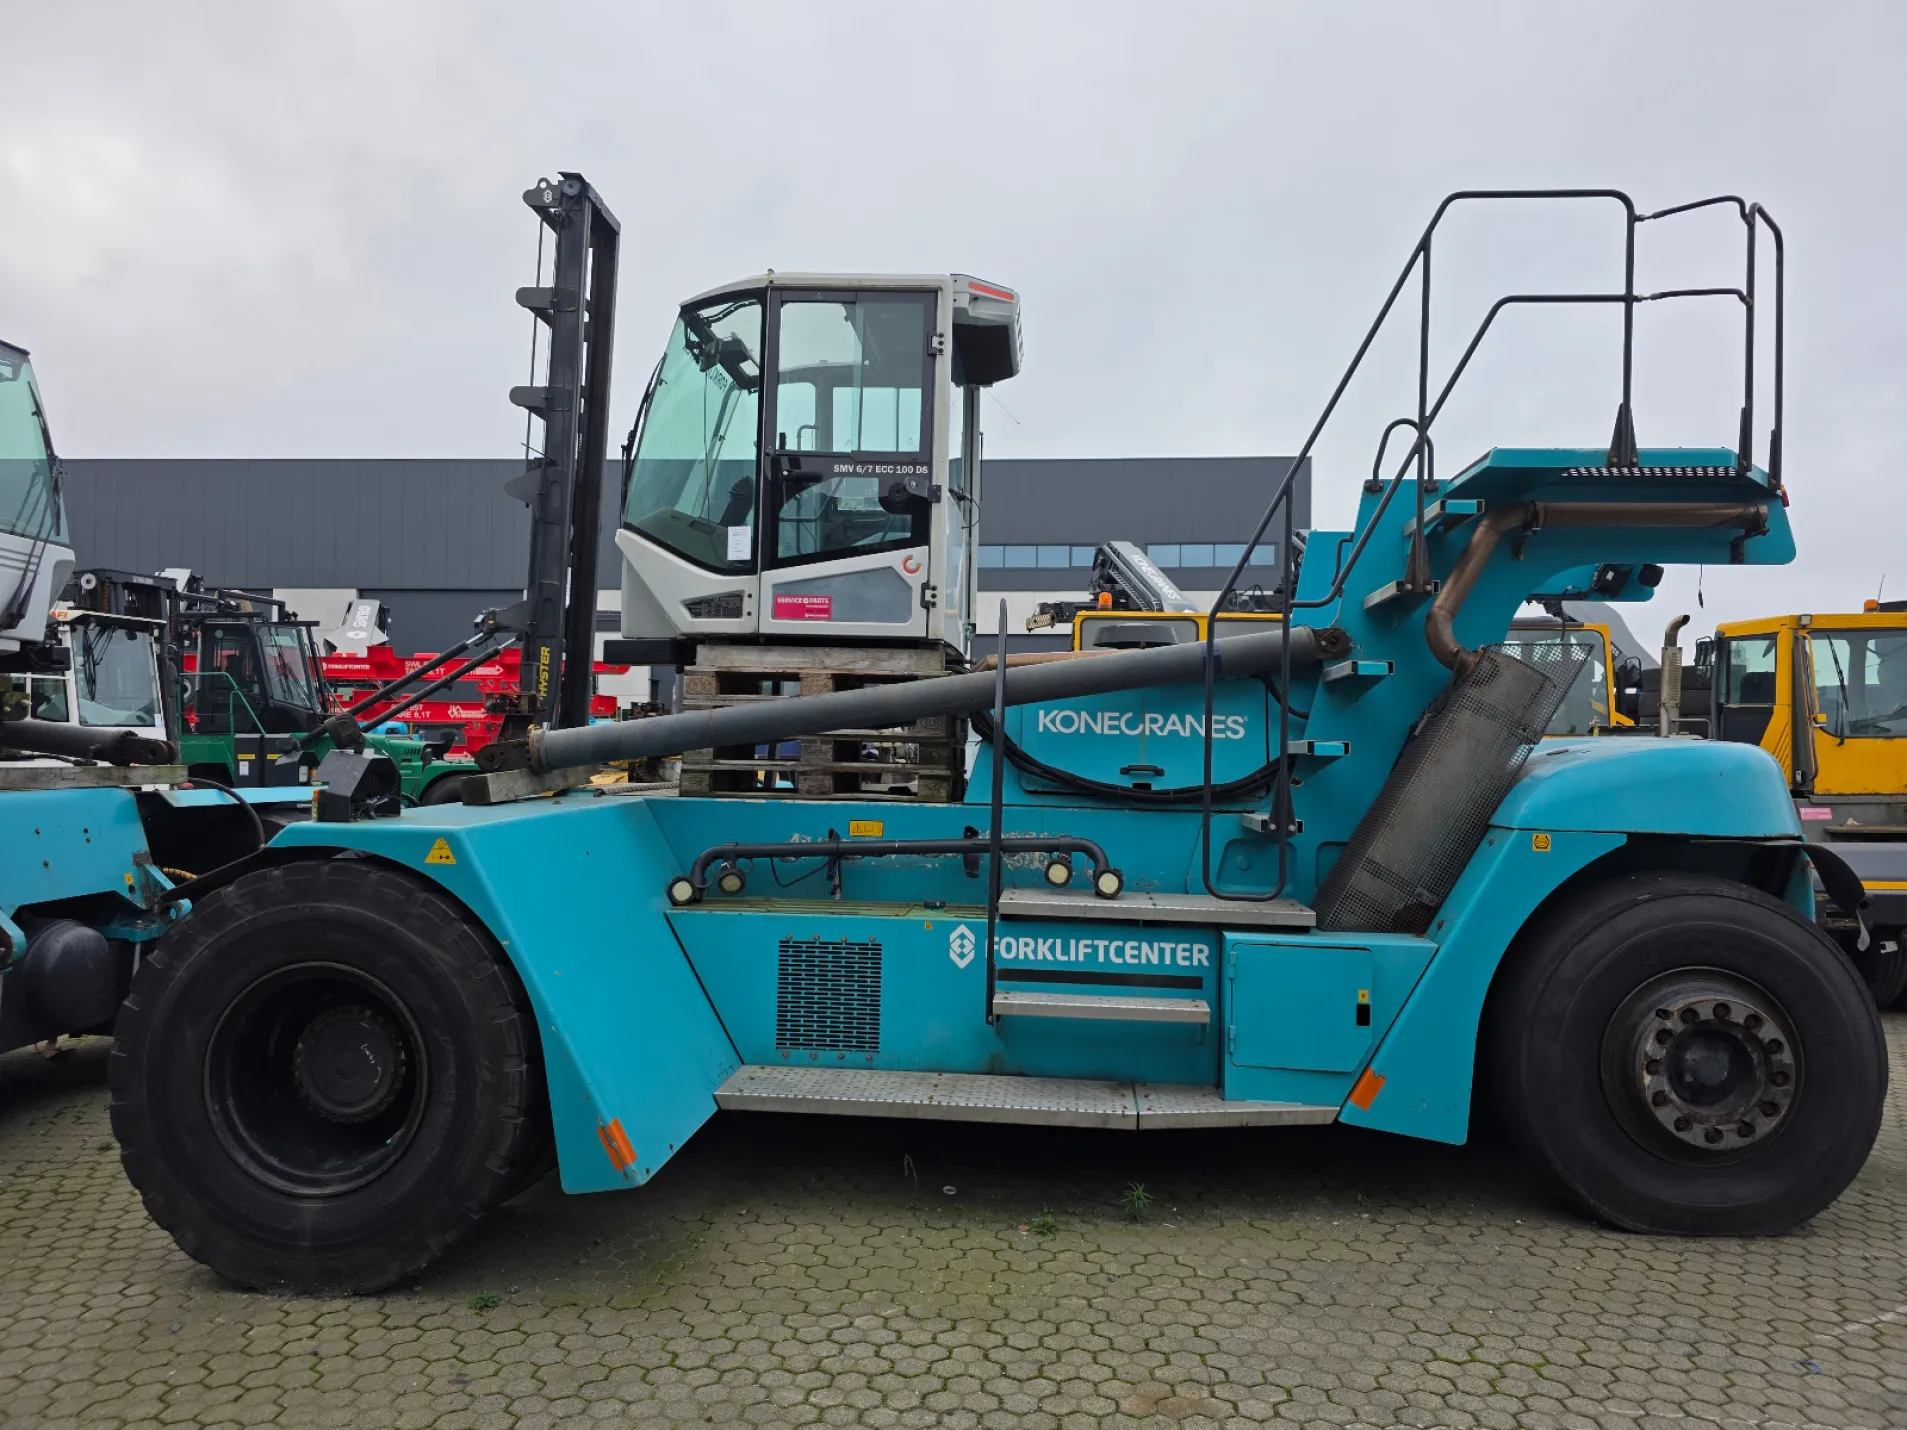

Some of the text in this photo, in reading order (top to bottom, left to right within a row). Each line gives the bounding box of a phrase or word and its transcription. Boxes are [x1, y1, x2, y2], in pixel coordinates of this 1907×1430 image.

[834, 464, 928, 475] SMV 6/7 ECC 100 DS
[538, 646, 550, 697] HYSTER
[1038, 709, 1246, 740] KONECRANES
